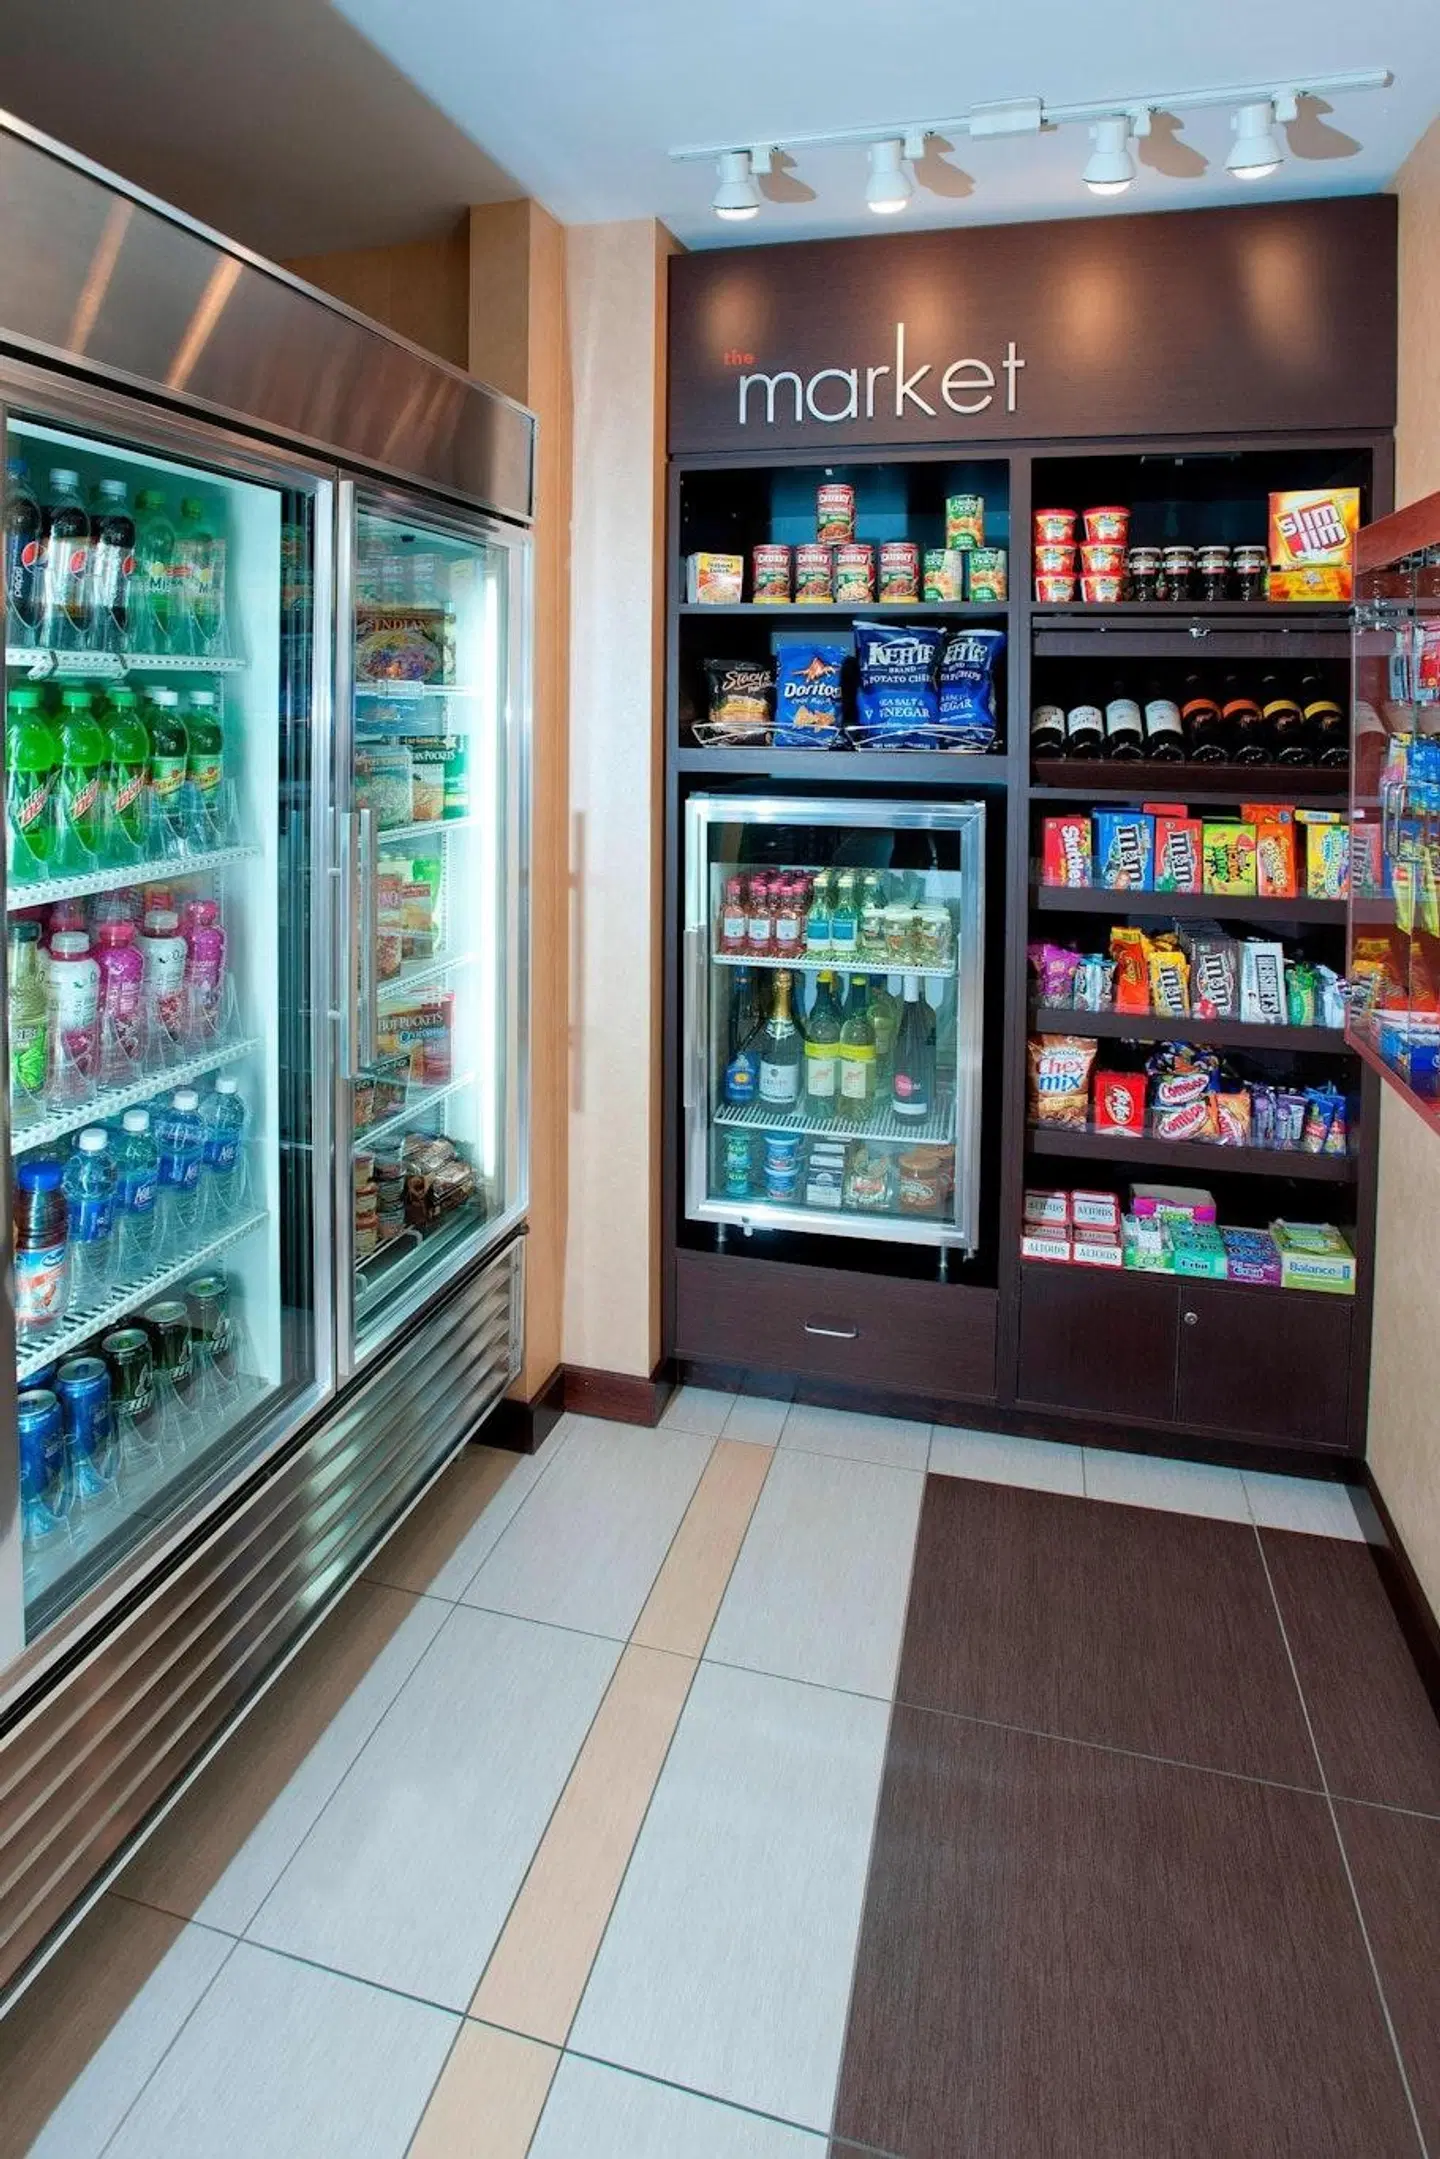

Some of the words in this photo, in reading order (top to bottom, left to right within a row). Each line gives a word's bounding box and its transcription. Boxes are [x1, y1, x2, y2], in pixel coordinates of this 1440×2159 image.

[723, 349, 755, 366] the
[738, 322, 1026, 425] market
[722, 670, 772, 692] Stacy's
[784, 682, 843, 699] Doritos
[1061, 825, 1084, 889] Skittles
[1039, 1073, 1084, 1092] mix
[1289, 1262, 1337, 1276] Balance
